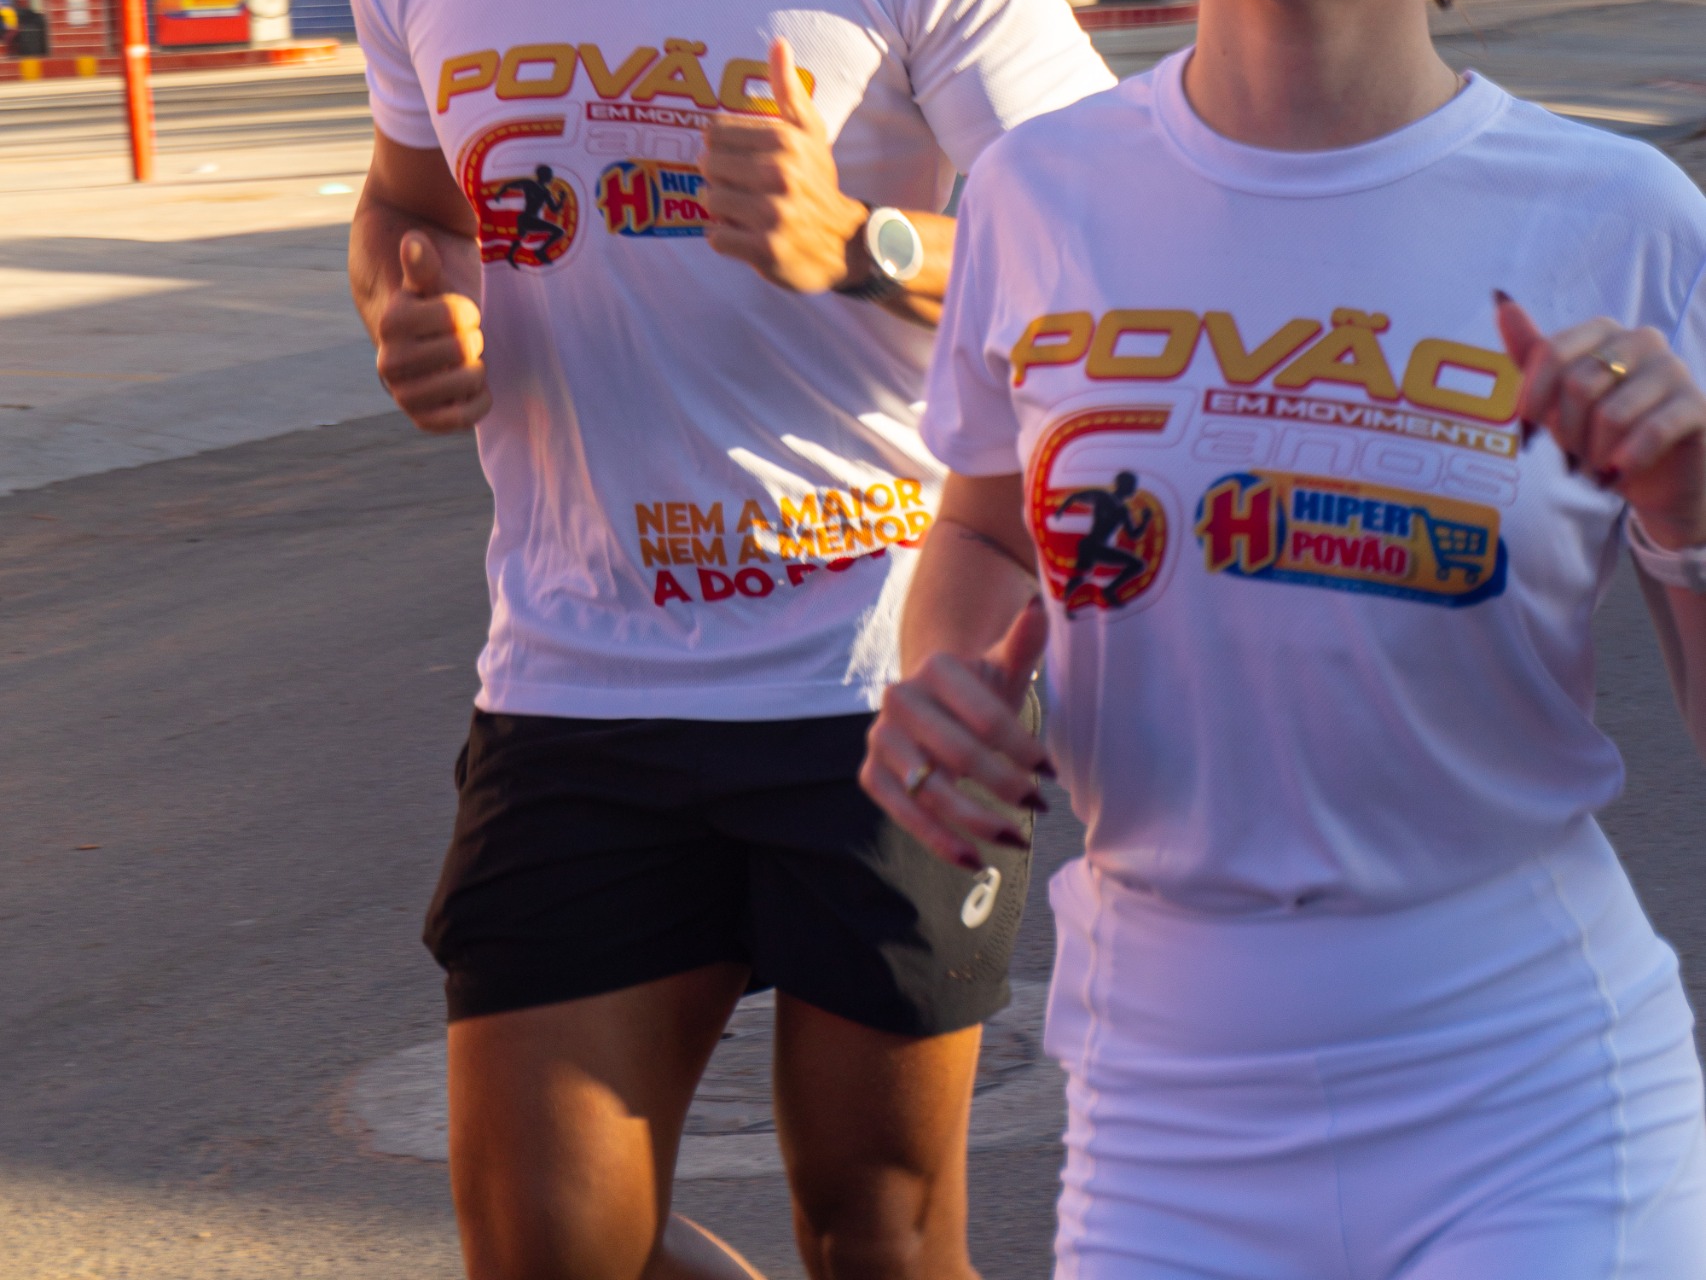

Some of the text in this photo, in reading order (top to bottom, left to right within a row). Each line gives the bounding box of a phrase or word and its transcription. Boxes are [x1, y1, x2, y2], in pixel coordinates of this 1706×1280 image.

[437, 37, 816, 117] POVÃO
[591, 104, 629, 121] EM
[585, 123, 700, 163] an
[659, 170, 706, 197] HIP
[1010, 307, 1526, 423] POVÃO
[1209, 393, 1513, 455] EM MOVIMENTO
[1192, 418, 1521, 507] anos
[634, 477, 925, 535] NEM A MAIOR
[1292, 489, 1411, 537] HIPER
[639, 534, 728, 568] NEM
[738, 532, 771, 565] A
[1291, 530, 1410, 578] POVÃO
[653, 567, 775, 608] A DO
